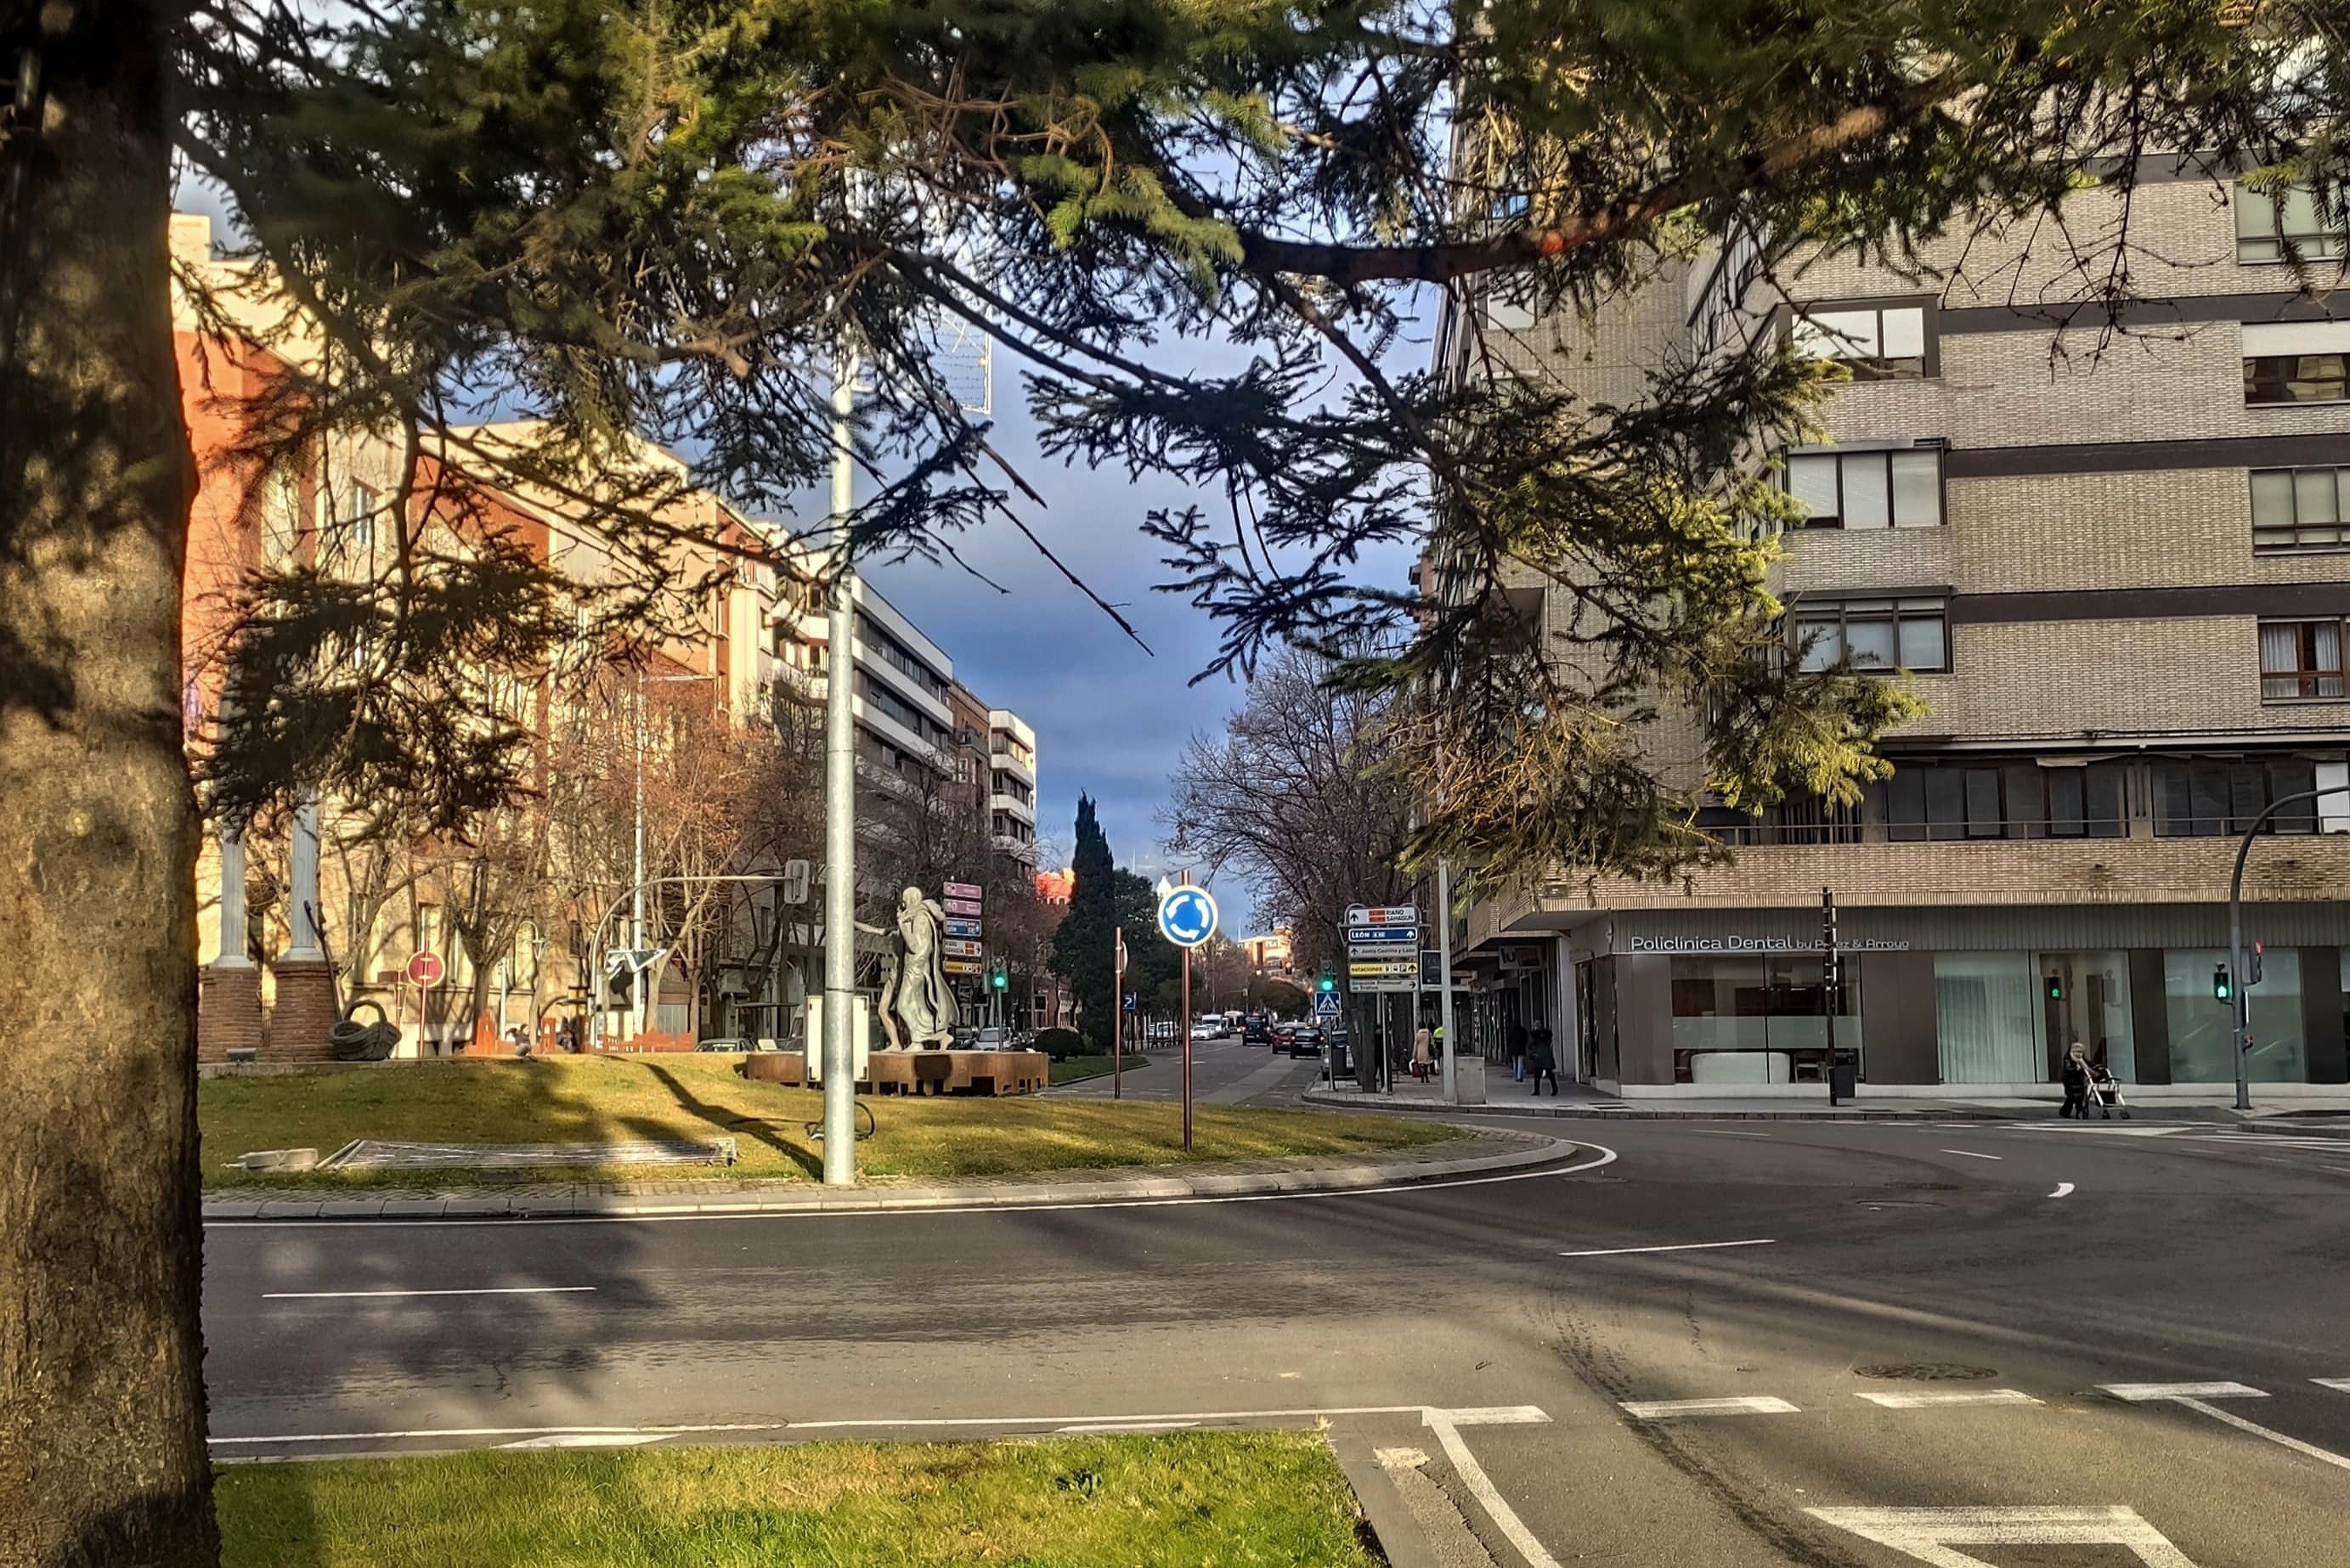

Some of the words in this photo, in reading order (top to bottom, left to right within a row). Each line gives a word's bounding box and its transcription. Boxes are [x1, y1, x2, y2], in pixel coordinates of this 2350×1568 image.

[1728, 934, 1792, 949] Dental
[1852, 938, 1863, 948] &
[1865, 937, 1911, 949] Arroyo
